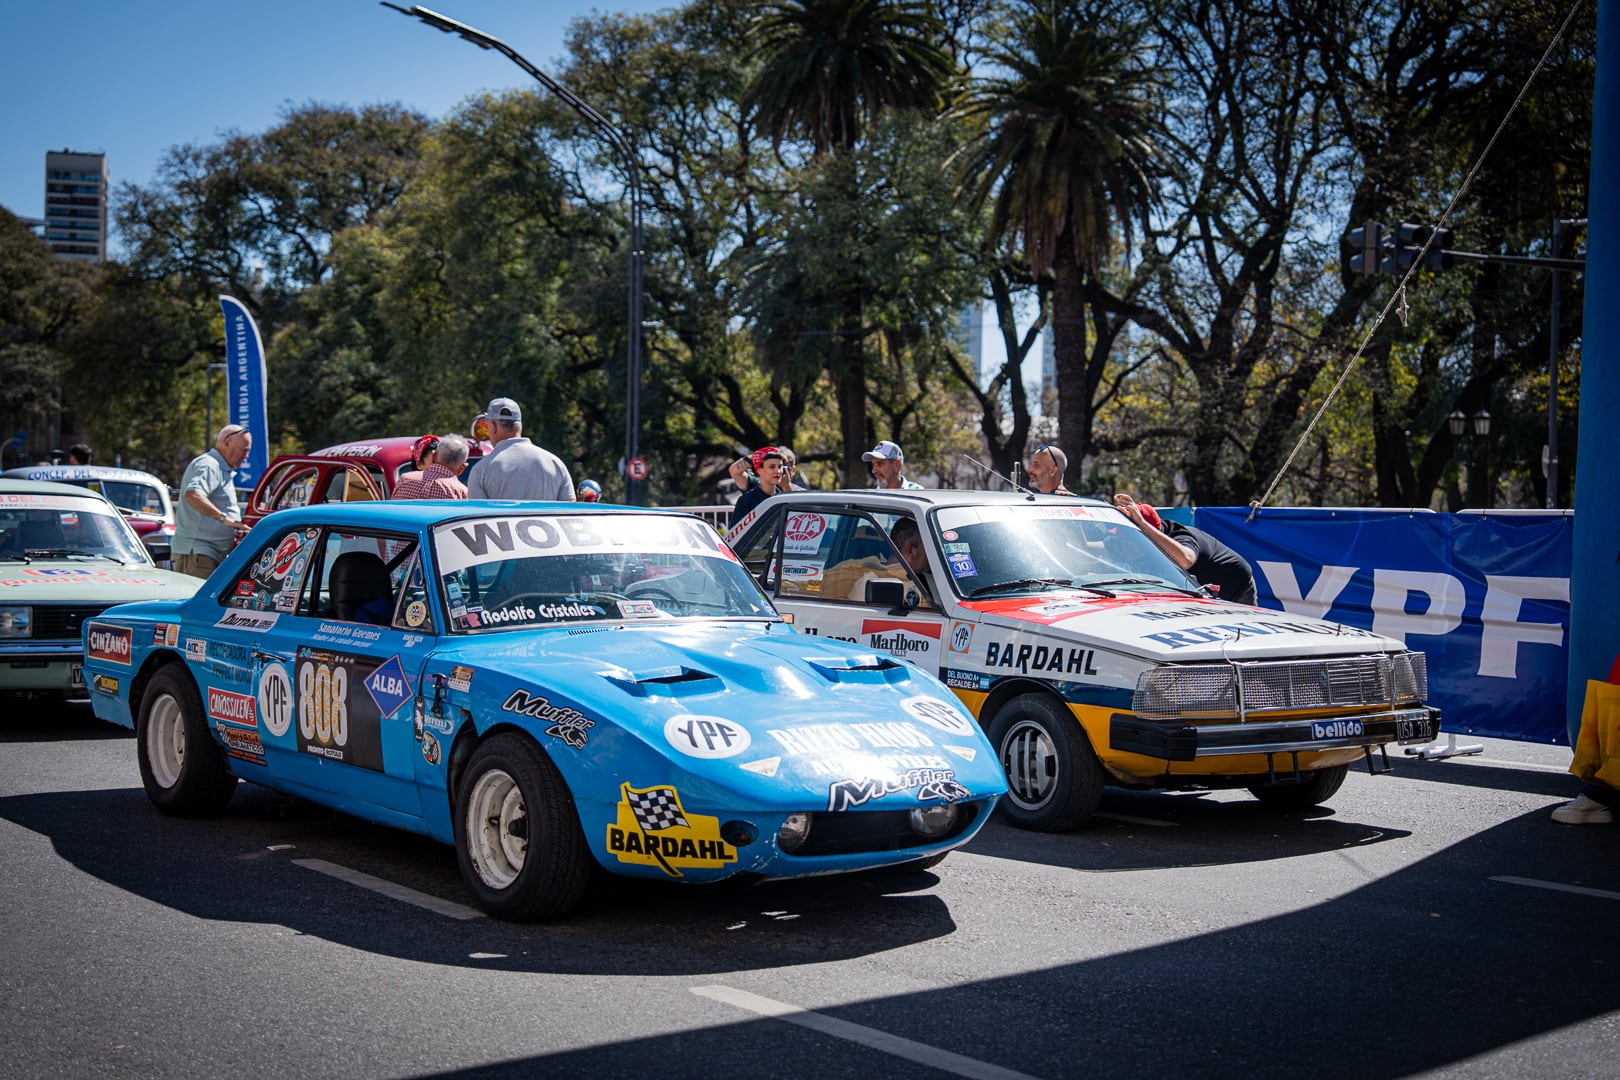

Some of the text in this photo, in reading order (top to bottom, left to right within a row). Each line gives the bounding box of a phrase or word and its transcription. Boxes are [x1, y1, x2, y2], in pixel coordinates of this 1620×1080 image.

[236, 314, 248, 381] ARGENTINA
[238, 384, 250, 428] NERGIA
[74, 469, 92, 479] DEL
[452, 518, 717, 557] WOBN
[725, 510, 757, 543] andi
[957, 561, 969, 571] 10
[480, 605, 536, 625] Rodolfo
[539, 601, 596, 618] Cristales
[1256, 560, 1571, 679] YPF
[90, 631, 129, 656] CINZANO
[318, 622, 381, 641] Sanatorio Guemes
[870, 633, 929, 653] Marlboro
[955, 627, 970, 647] YPF
[985, 641, 1098, 675] BARDAHL
[371, 673, 404, 697] ALBA
[946, 678, 971, 689] RECALDE
[947, 670, 956, 680] DEL
[956, 671, 973, 681] BUONO
[264, 674, 288, 725] YPF
[299, 661, 348, 747] 808
[502, 688, 596, 730] Muffler
[912, 701, 967, 730] YPF
[1314, 721, 1361, 739] bellido
[1417, 720, 1432, 738] 316
[677, 719, 740, 750] YPF
[850, 721, 935, 750] HNOS
[811, 754, 951, 776] AUOVILES
[827, 768, 955, 812] Muffler
[610, 826, 735, 868] BARDAHL
